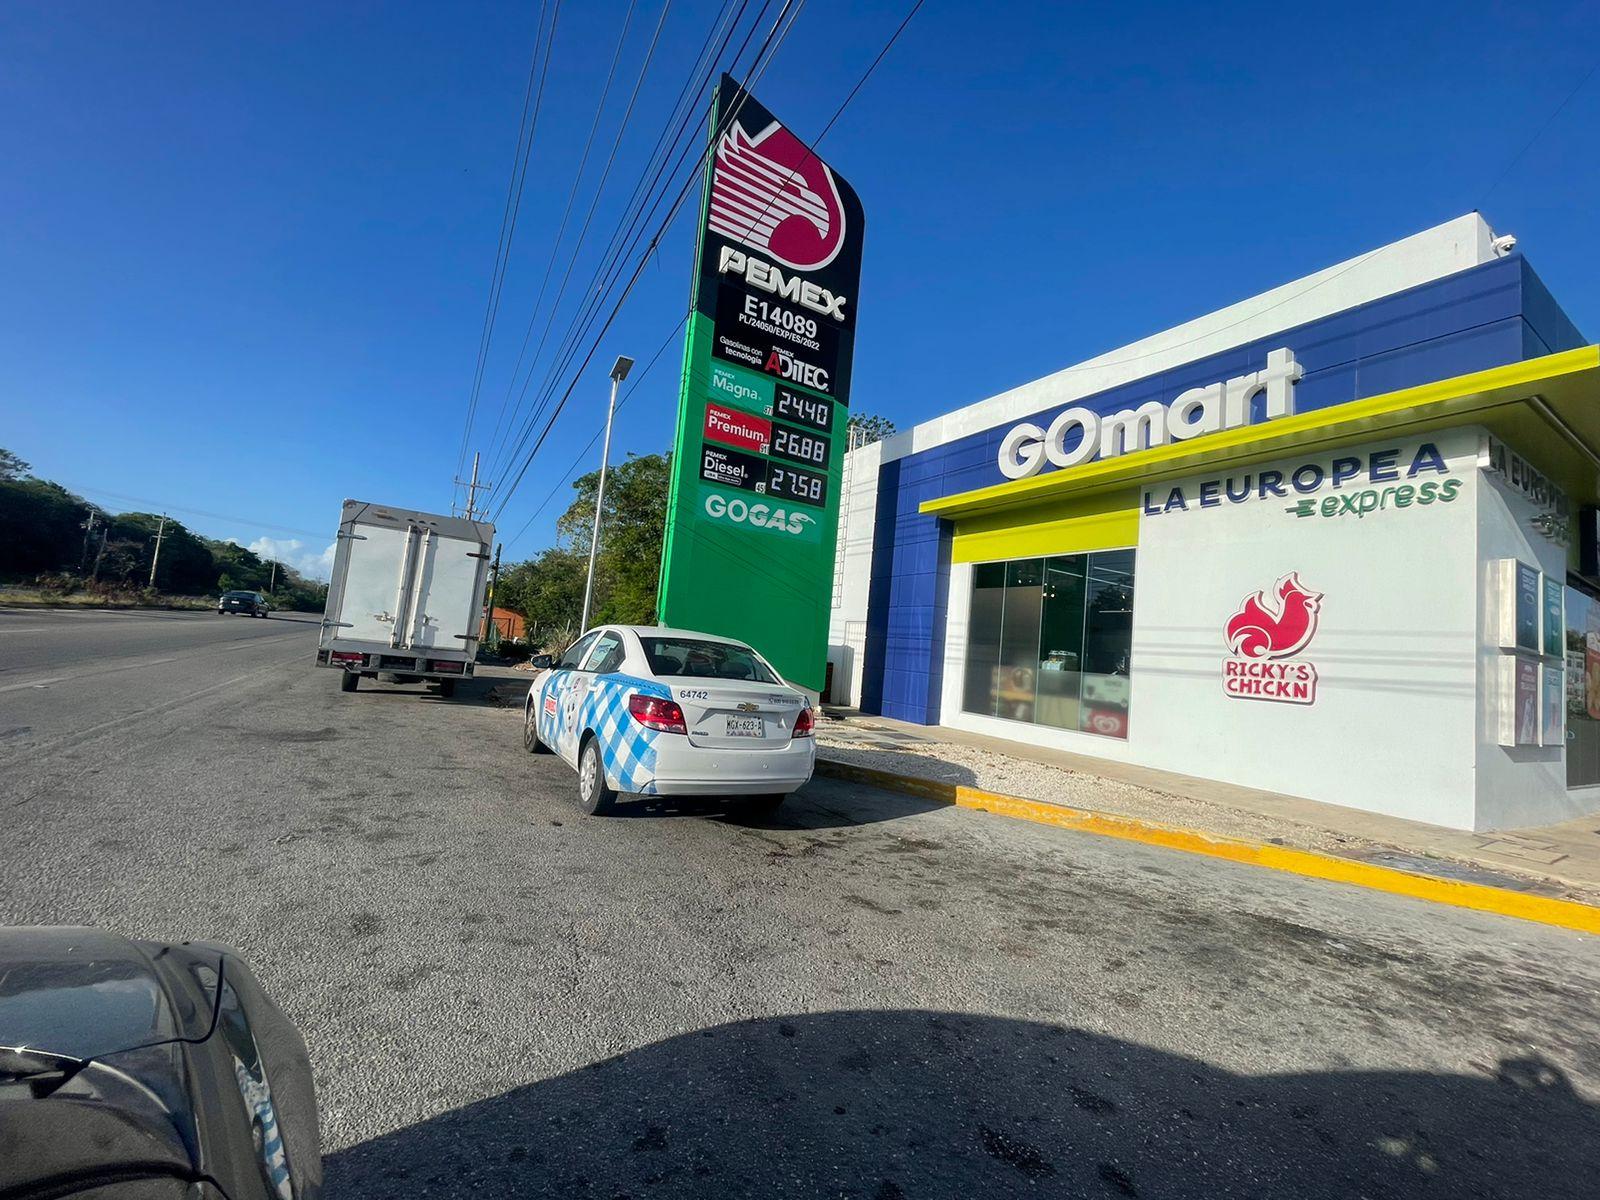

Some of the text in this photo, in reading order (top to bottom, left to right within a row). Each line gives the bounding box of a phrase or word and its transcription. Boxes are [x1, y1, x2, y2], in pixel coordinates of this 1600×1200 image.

[718, 245, 847, 322] PEMEX
[744, 294, 818, 339] E14089
[738, 313, 820, 351] PL/24050/EXP/ES/2022
[720, 336, 763, 357] Gasolinas con
[713, 375, 758, 400] Magna
[998, 347, 1305, 480] GOmart
[708, 415, 764, 442] Premium
[704, 456, 744, 478] Diesel
[705, 450, 728, 461] PEMEX
[1144, 442, 1450, 516] LA EUROPEA
[705, 494, 816, 535] GOGAS
[1226, 661, 1310, 681] RICKY'S
[680, 690, 708, 700] 64742
[1227, 678, 1308, 699] CHICKN
[726, 719, 762, 731] MGX-623-A
